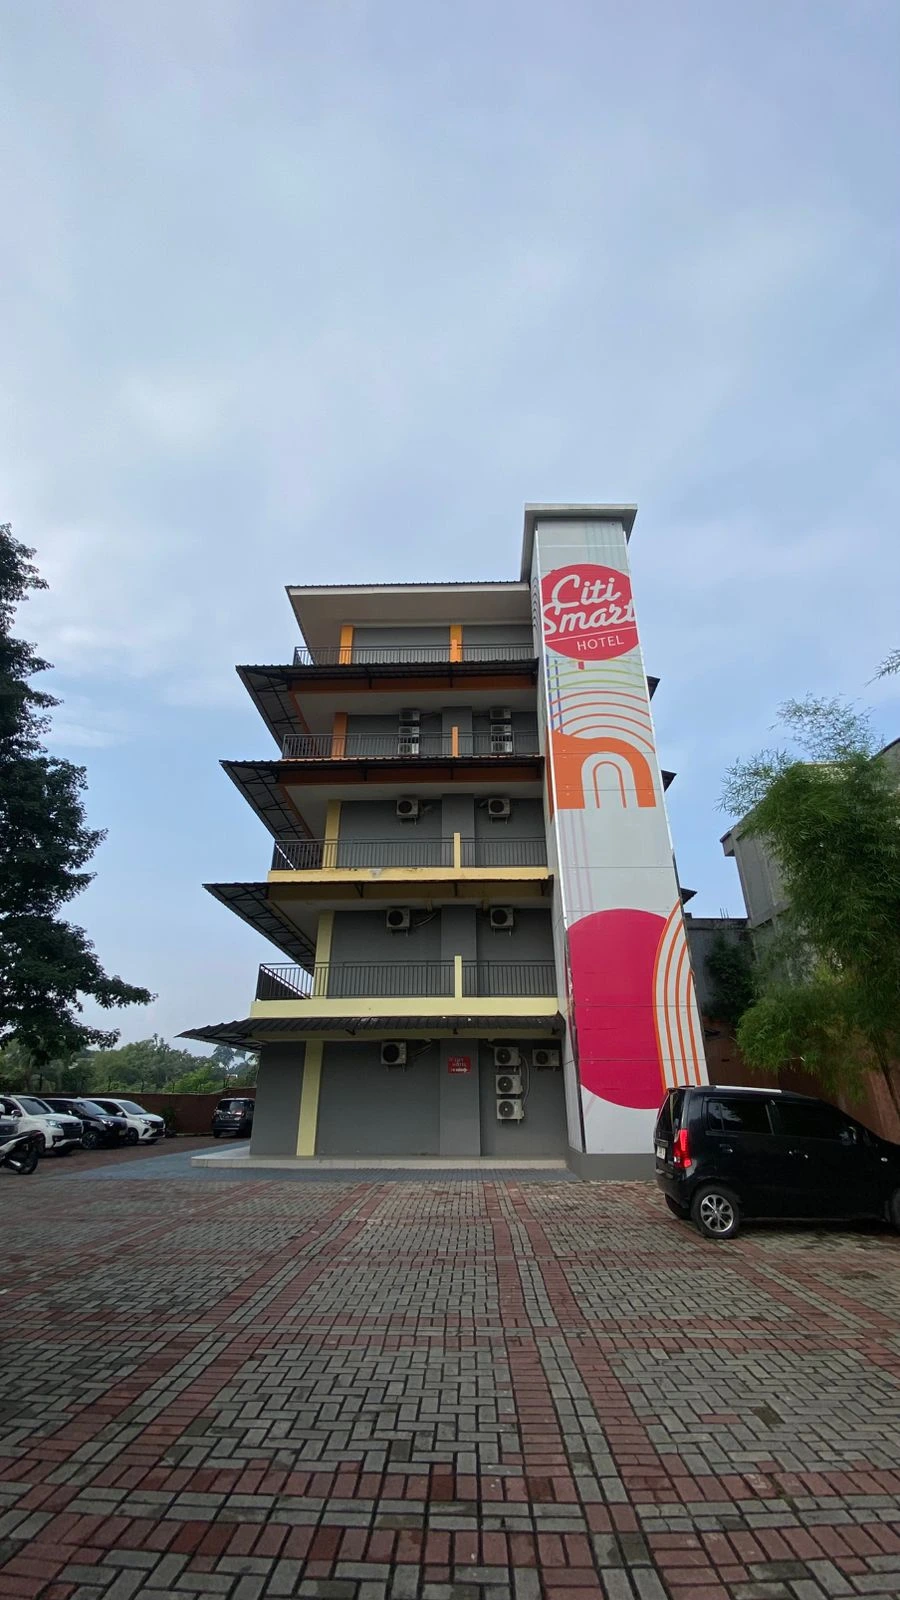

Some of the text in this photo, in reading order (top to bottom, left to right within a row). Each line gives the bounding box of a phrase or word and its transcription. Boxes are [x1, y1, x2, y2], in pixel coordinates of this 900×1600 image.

[551, 574, 622, 611] Citi
[542, 599, 636, 635] Smart
[576, 635, 625, 651] HOTEL
